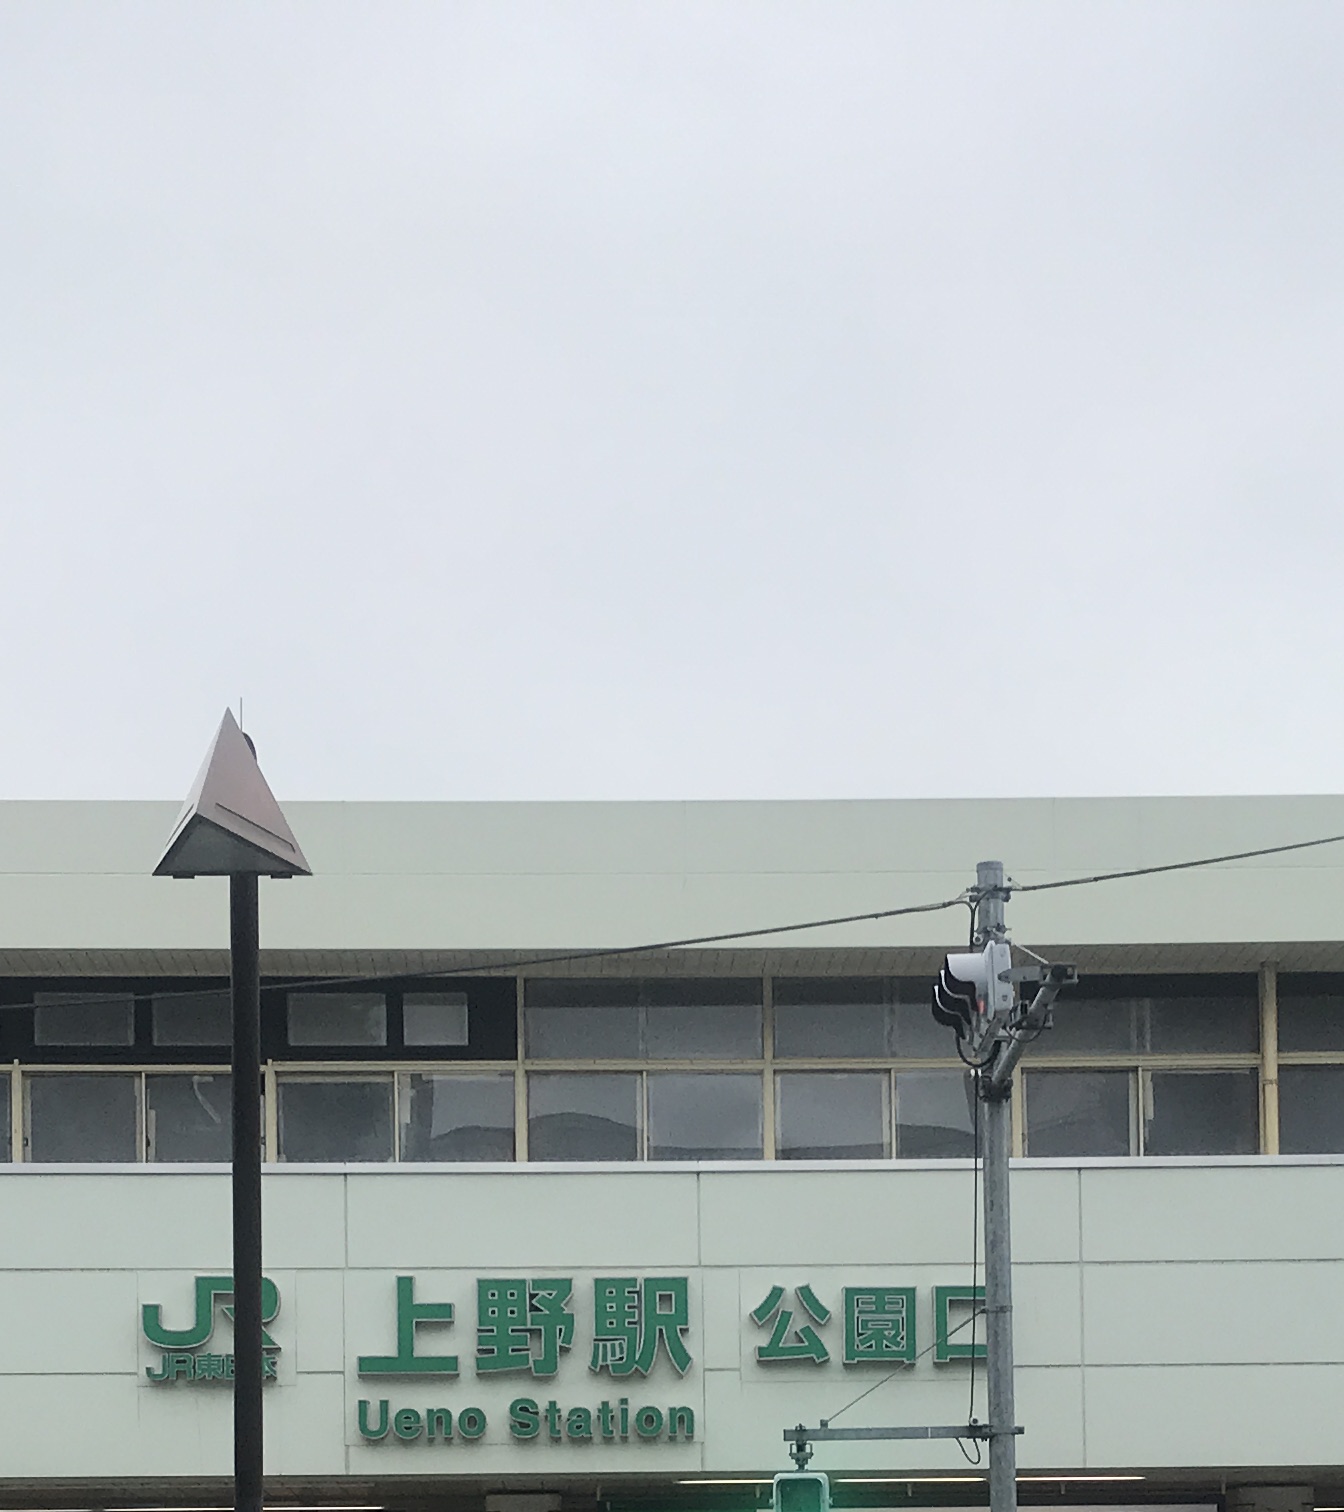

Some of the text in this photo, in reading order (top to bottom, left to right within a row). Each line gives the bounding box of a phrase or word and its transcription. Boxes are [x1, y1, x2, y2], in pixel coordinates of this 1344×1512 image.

[142, 1276, 281, 1349] JR
[357, 1276, 693, 1377] 上野駅
[749, 1284, 987, 1363] 公園口
[357, 1397, 695, 1439] Ueno Station
